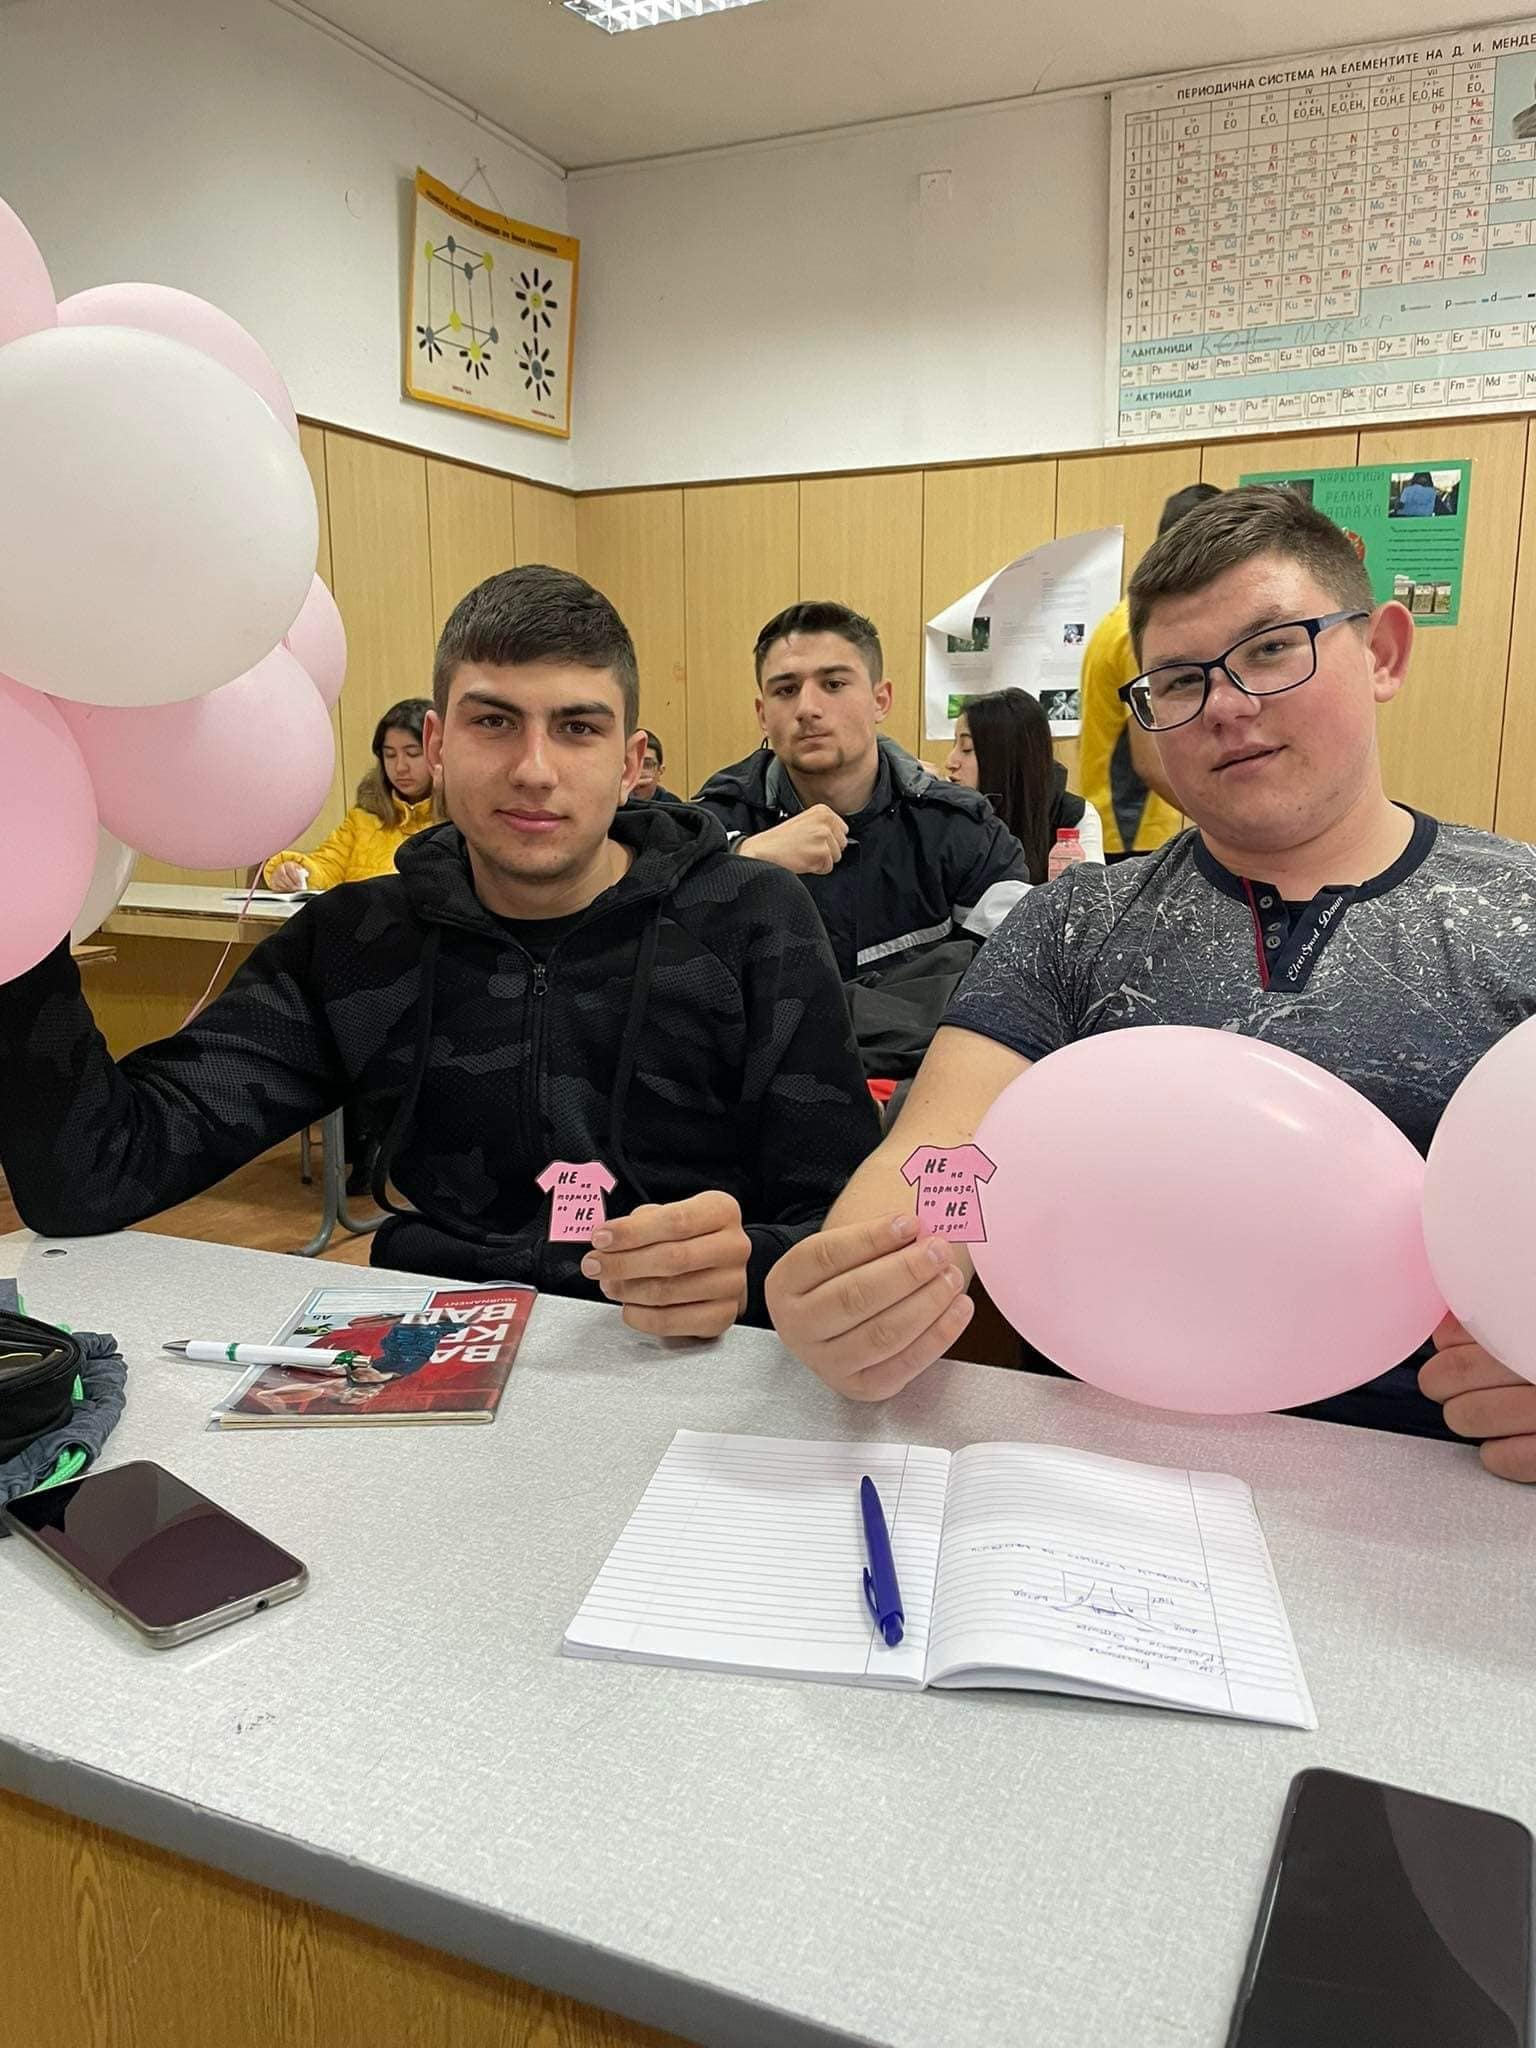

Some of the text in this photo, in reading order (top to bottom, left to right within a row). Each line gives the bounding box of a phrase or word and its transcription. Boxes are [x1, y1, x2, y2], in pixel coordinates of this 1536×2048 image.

[1177, 78, 1255, 100] ПЕРИОДИЧНА
[1258, 69, 1315, 87] СИСТЕМА
[1320, 64, 1337, 77] НА
[1341, 52, 1419, 74] ЕЛЕМЕНТИТЕ
[1426, 49, 1443, 60] НА
[1495, 184, 1508, 193] Rh
[1451, 231, 1464, 241] Os
[1128, 247, 1135, 257] 5
[1127, 289, 1134, 299] 6
[1490, 291, 1498, 302] d
[1248, 355, 1263, 365] Sm
[1280, 351, 1292, 361] Eu
[1378, 340, 1393, 352] Dy
[1416, 336, 1430, 346] Ho
[1453, 333, 1463, 343] Er
[1489, 328, 1501, 338] Tu
[1136, 388, 1192, 402] АКТИНИДИ
[1246, 401, 1258, 411] Pu
[1413, 384, 1426, 394] Es
[1450, 380, 1465, 390] Fm
[1485, 377, 1501, 387] Md
[924, 1158, 963, 1179] НЕ на
[558, 1171, 578, 1185] НЕ
[575, 1207, 595, 1221] НЕ
[945, 1201, 969, 1217] НЕ
[443, 1297, 519, 1307] TOURNAMENT
